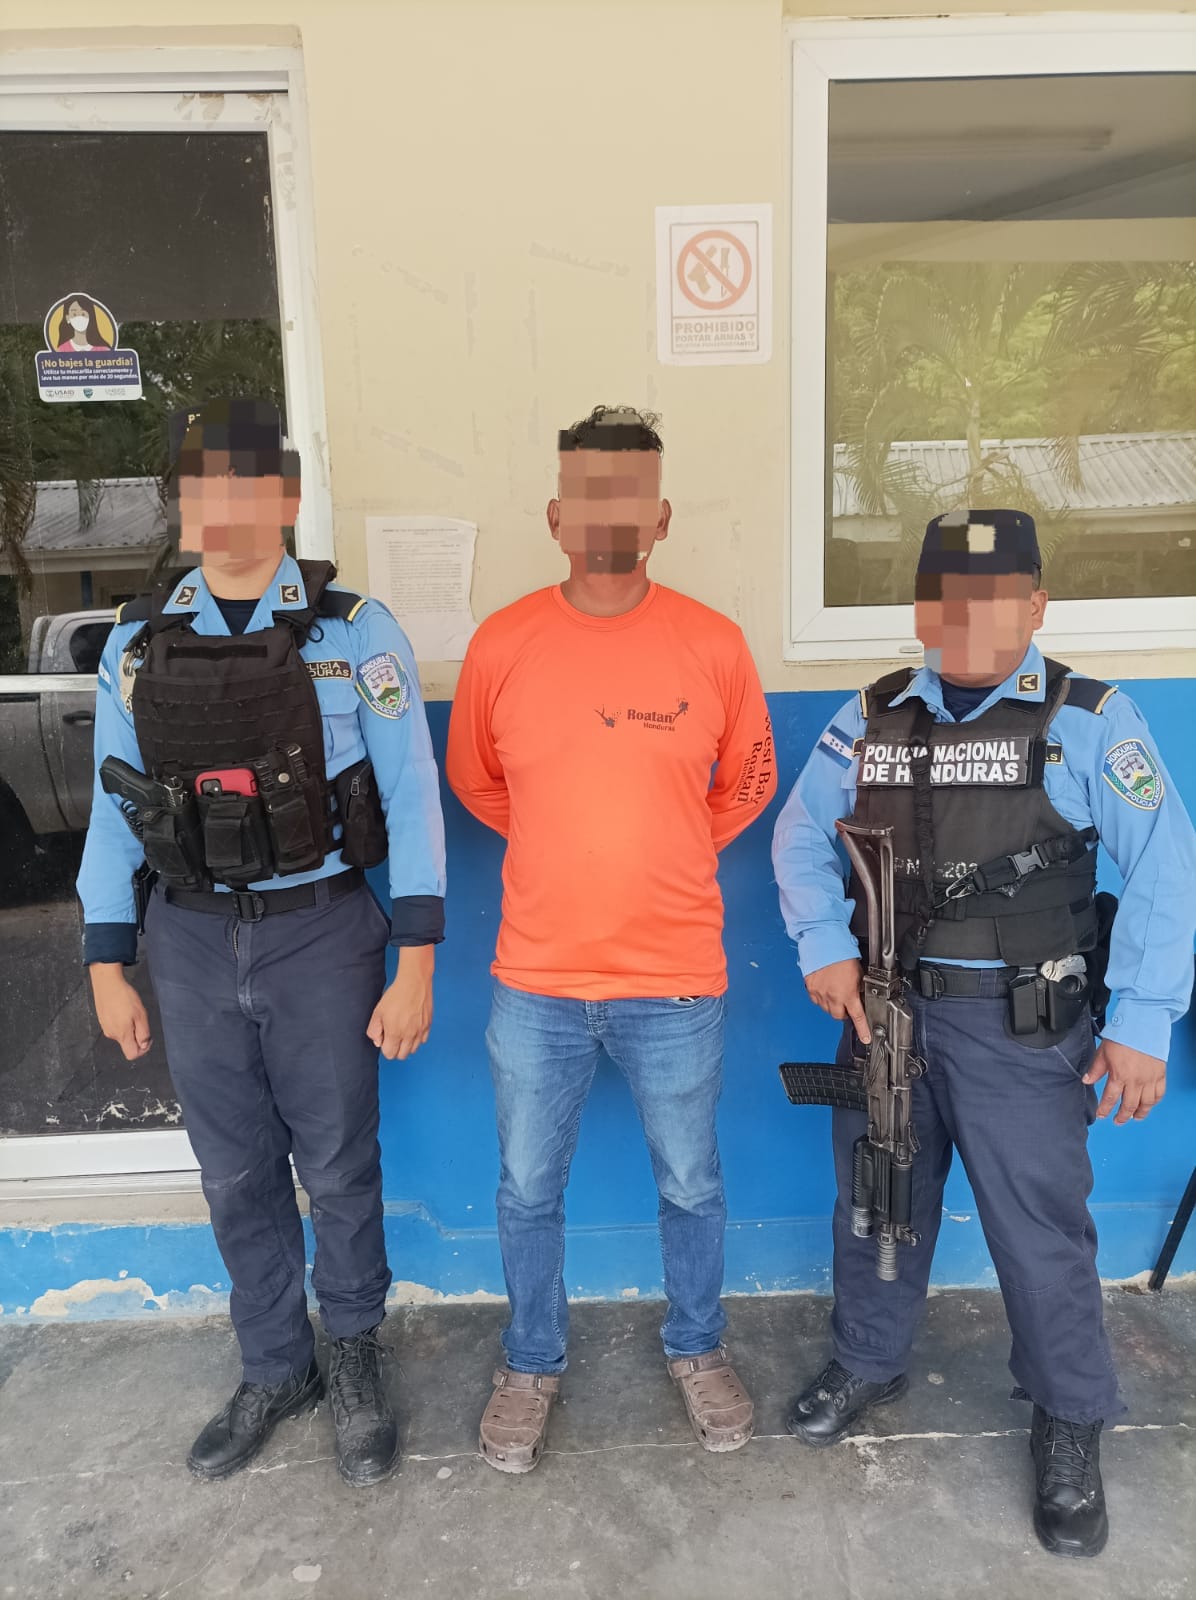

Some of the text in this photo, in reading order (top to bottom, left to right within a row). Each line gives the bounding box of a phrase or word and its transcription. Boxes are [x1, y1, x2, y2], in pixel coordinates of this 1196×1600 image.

[675, 321, 755, 334] PROHIBIDO
[675, 334, 711, 342] PORTAR
[714, 333, 746, 341] ARMAS
[59, 358, 83, 369] bajes
[84, 358, 94, 367] la
[95, 357, 133, 369] guardia!
[306, 662, 340, 670] LICIA
[309, 669, 350, 677] DURAS
[627, 708, 674, 724] Roatan
[643, 722, 676, 732] Honduras
[864, 741, 1020, 763] POLICIA NACIONAL
[1106, 743, 1138, 766] HONDURAS
[737, 741, 763, 802] Roatan
[862, 762, 1019, 783] DE HNDURAS
[751, 771, 771, 805] Bay
[1125, 791, 1153, 807] POLICIA
